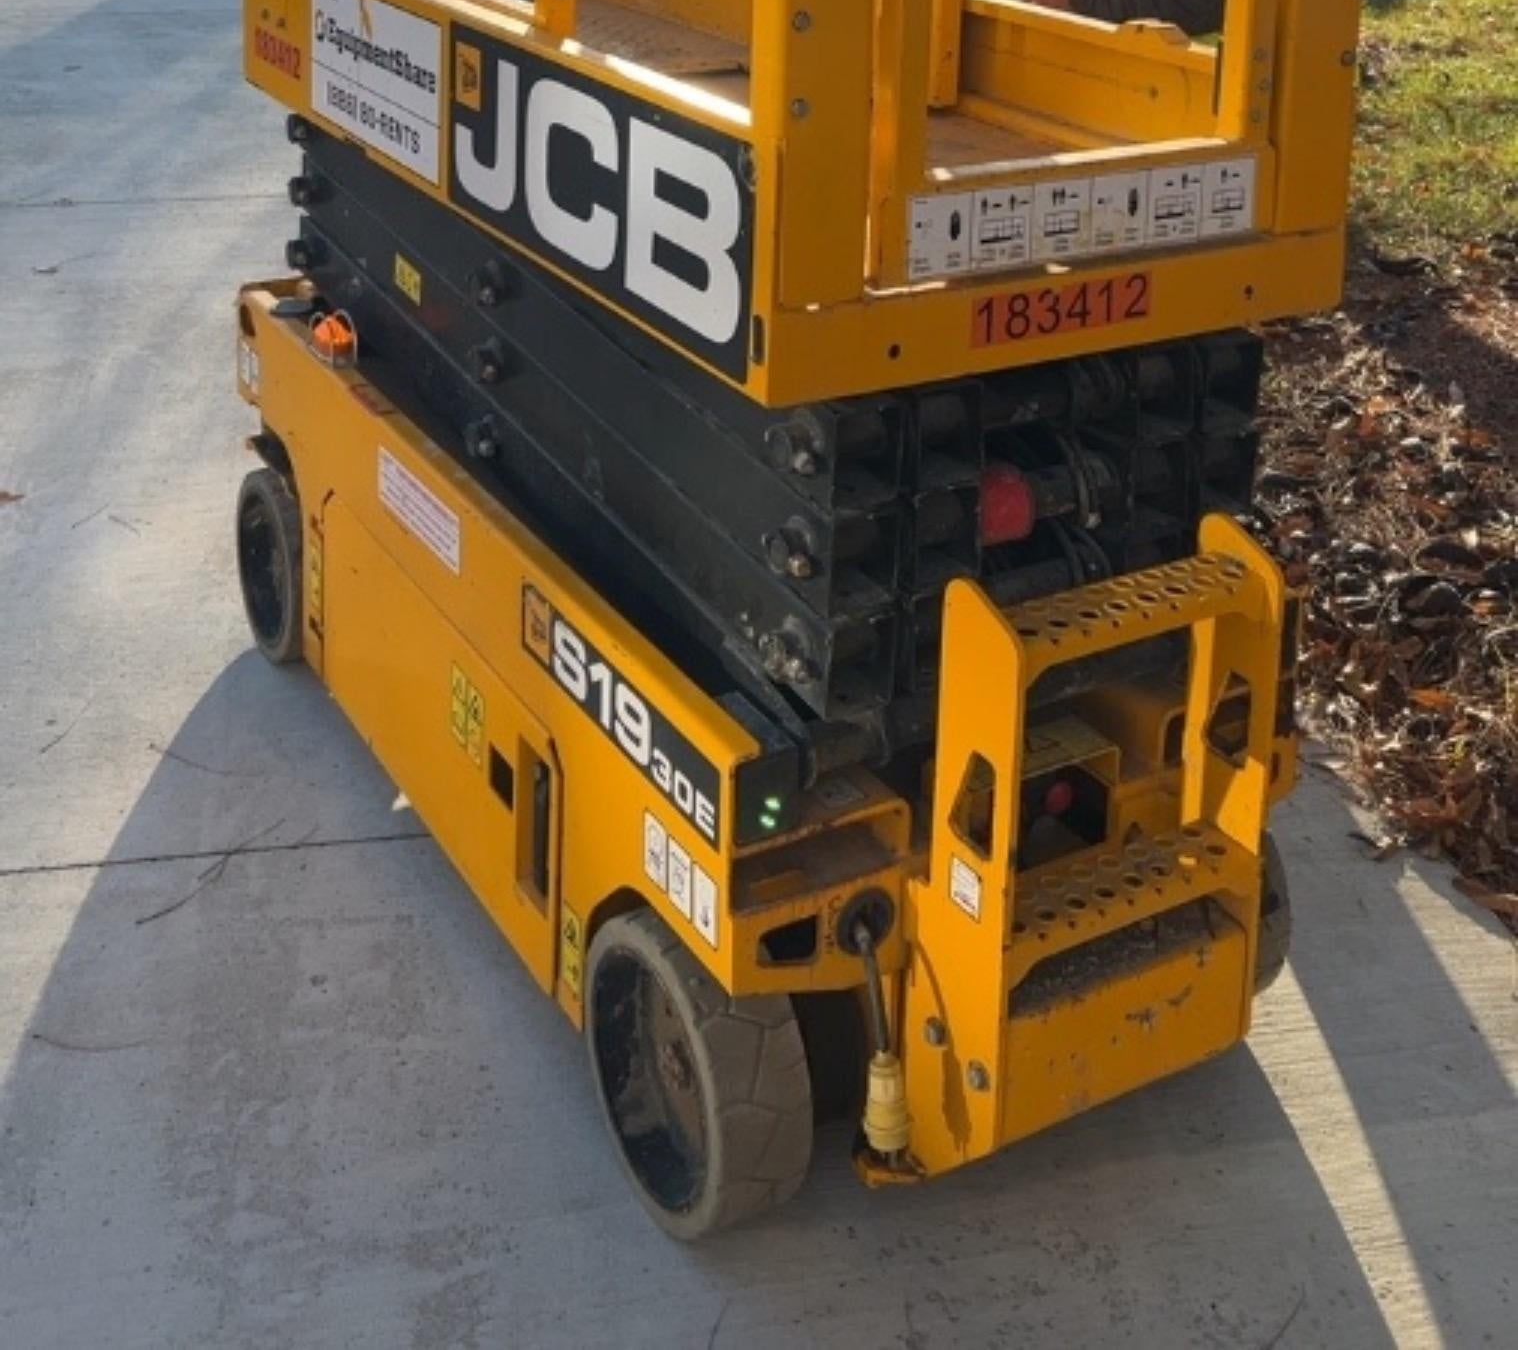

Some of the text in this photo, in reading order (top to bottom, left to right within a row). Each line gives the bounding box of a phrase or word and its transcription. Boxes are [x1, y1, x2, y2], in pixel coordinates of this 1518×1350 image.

[326, 16, 437, 94] EquipmentShare
[454, 58, 742, 344] JCB
[976, 272, 1149, 344] 183412
